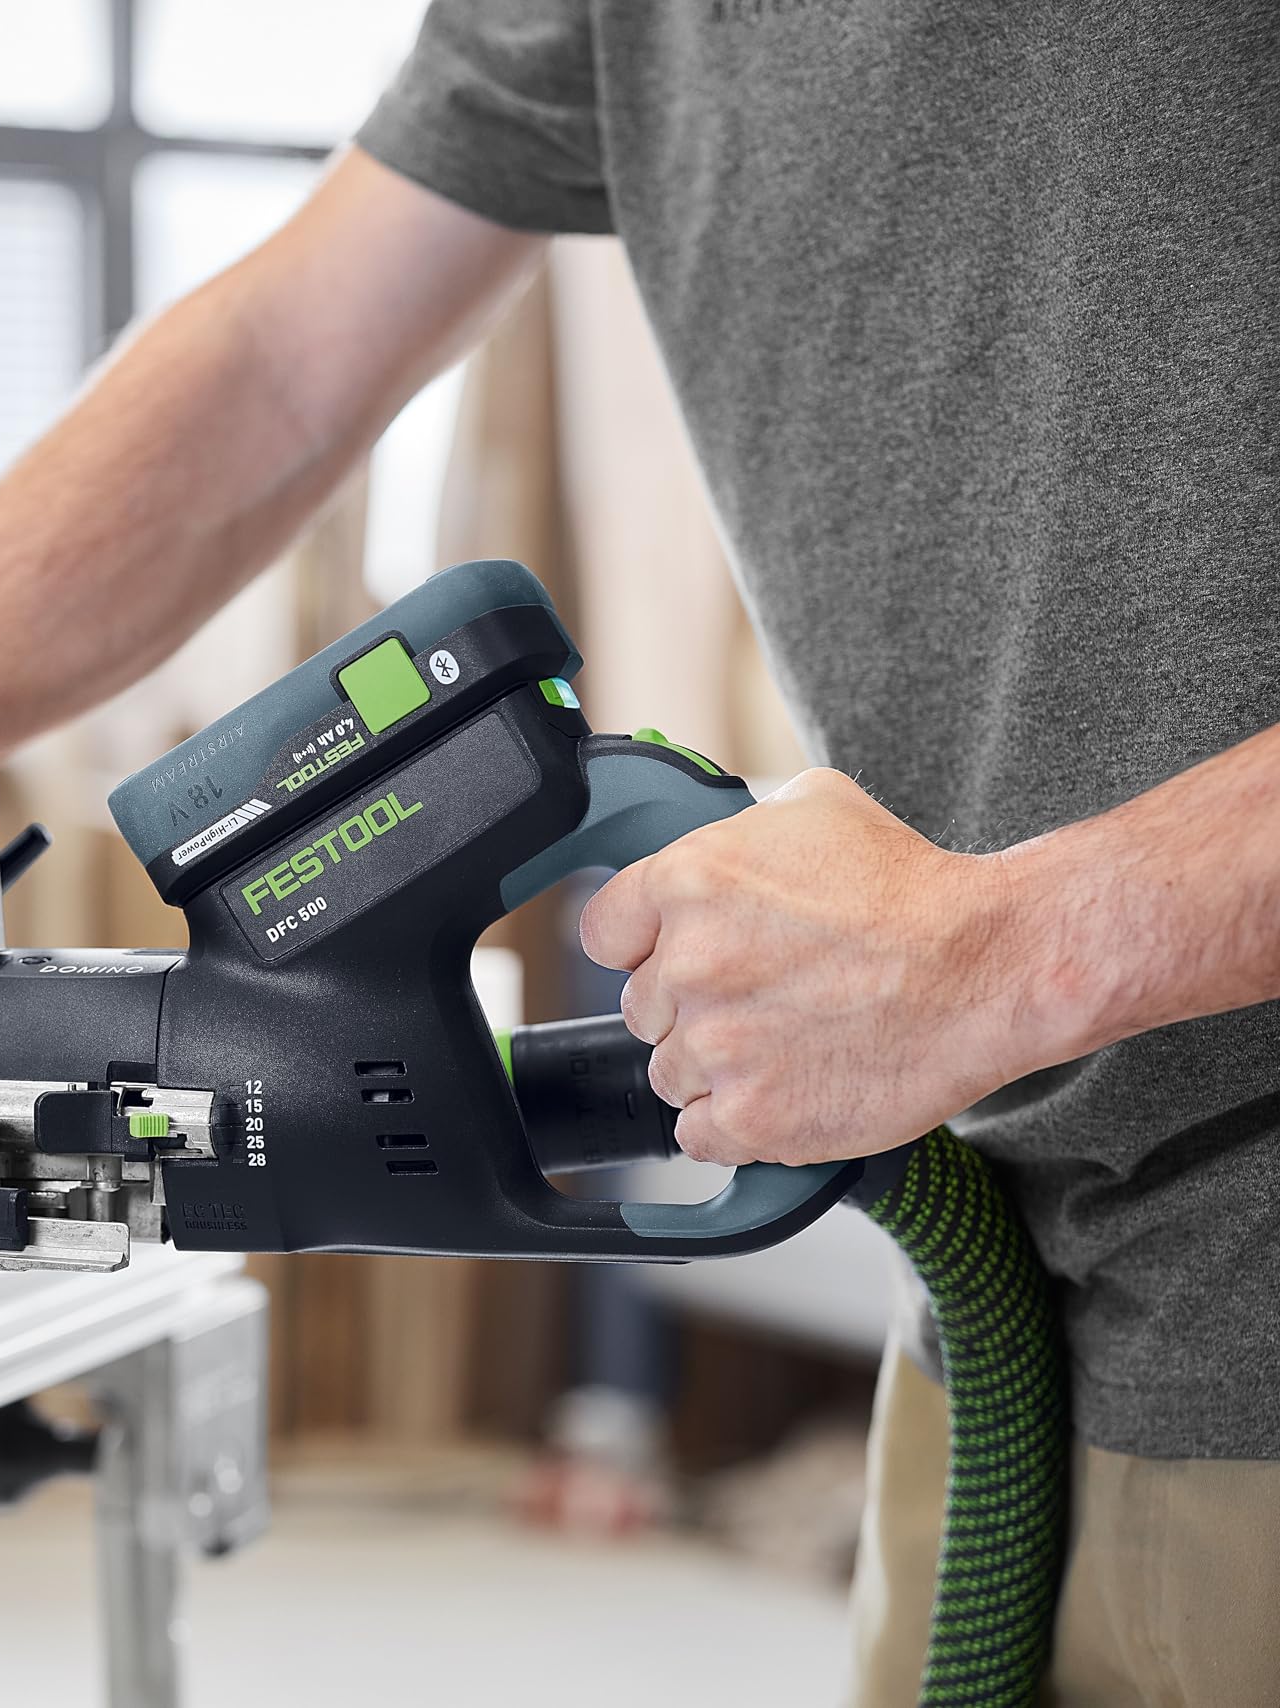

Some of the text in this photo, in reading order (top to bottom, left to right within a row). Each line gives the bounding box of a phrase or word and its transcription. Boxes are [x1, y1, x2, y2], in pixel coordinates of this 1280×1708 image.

[316, 728, 335, 746] Ah
[151, 720, 245, 793] AIRSTREAM
[275, 732, 366, 793] FESTOOL
[167, 775, 223, 827] 18 V
[177, 817, 239, 860] Li-HighPower
[241, 792, 424, 916] FESTOOL
[266, 896, 328, 943] DFC 500
[39, 965, 144, 974] DOMINO
[245, 1080, 262, 1094] 12
[245, 1099, 262, 1113] 15
[245, 1117, 263, 1131] 20
[246, 1135, 264, 1149] 25
[248, 1153, 266, 1166] 28
